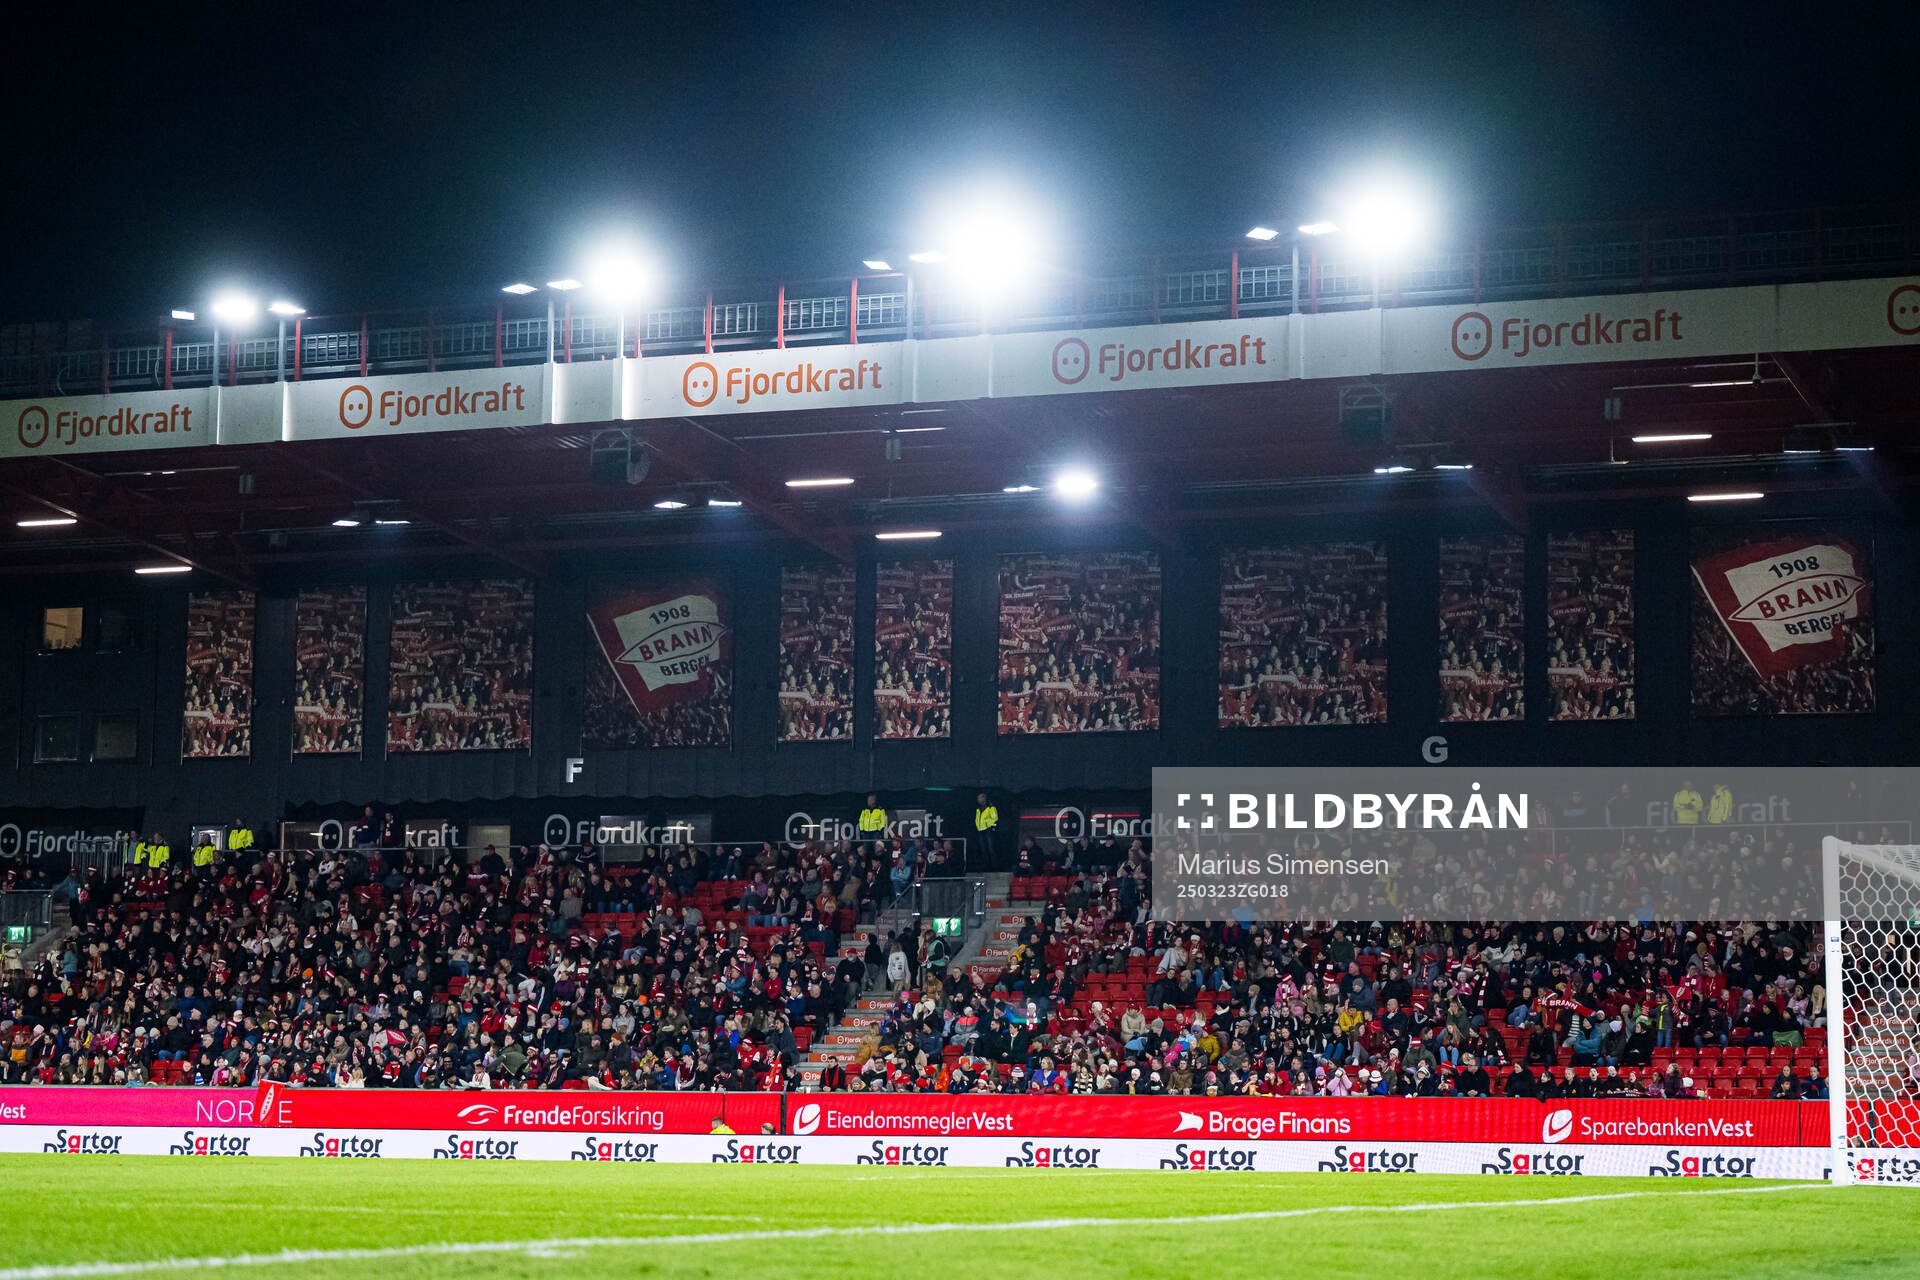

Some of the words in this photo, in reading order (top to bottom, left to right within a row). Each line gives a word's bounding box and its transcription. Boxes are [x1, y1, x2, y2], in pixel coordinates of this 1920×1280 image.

[1501, 309, 1683, 357] Fjordkraft
[1099, 334, 1266, 382] Fjordkraft
[726, 358, 883, 405] Fjordkraft
[380, 382, 525, 426] Fjordkraft
[56, 404, 192, 445] Fjordkraft
[1769, 556, 1820, 578] 1908
[1758, 578, 1848, 618] BRANN
[649, 605, 690, 624] 1908
[639, 625, 713, 660] BRANN
[1421, 735, 1449, 763] G
[566, 758, 583, 783] F
[1647, 795, 1791, 832] Fjraft
[348, 822, 459, 848] Fkraft
[576, 820, 694, 846] Fjordkraft
[820, 813, 944, 846] Fjokraft
[26, 830, 129, 858] Fjordkraft
[1549, 1000, 1578, 1010] BRANN
[196, 1100, 293, 1123] NORE
[504, 1105, 664, 1130] FrendeForsikring
[827, 1111, 1014, 1134] EiendomsmeglerVest
[1209, 1111, 1276, 1139] Brage
[1279, 1112, 1351, 1133] Finans
[1580, 1117, 1754, 1140] SparebankenVest
[57, 1129, 122, 1150] Sartor
[184, 1131, 250, 1151] Sartor
[314, 1132, 383, 1153] Sartor
[448, 1134, 518, 1155] Sartor
[585, 1136, 659, 1157] Sartor
[727, 1139, 801, 1160] Sartor
[872, 1141, 948, 1162] Sartor
[1021, 1142, 1100, 1163] Sartor
[1175, 1144, 1257, 1166] Sartor
[1334, 1146, 1418, 1168] Sartor
[1498, 1148, 1585, 1170] Sartor
[1666, 1150, 1755, 1173] Sartor
